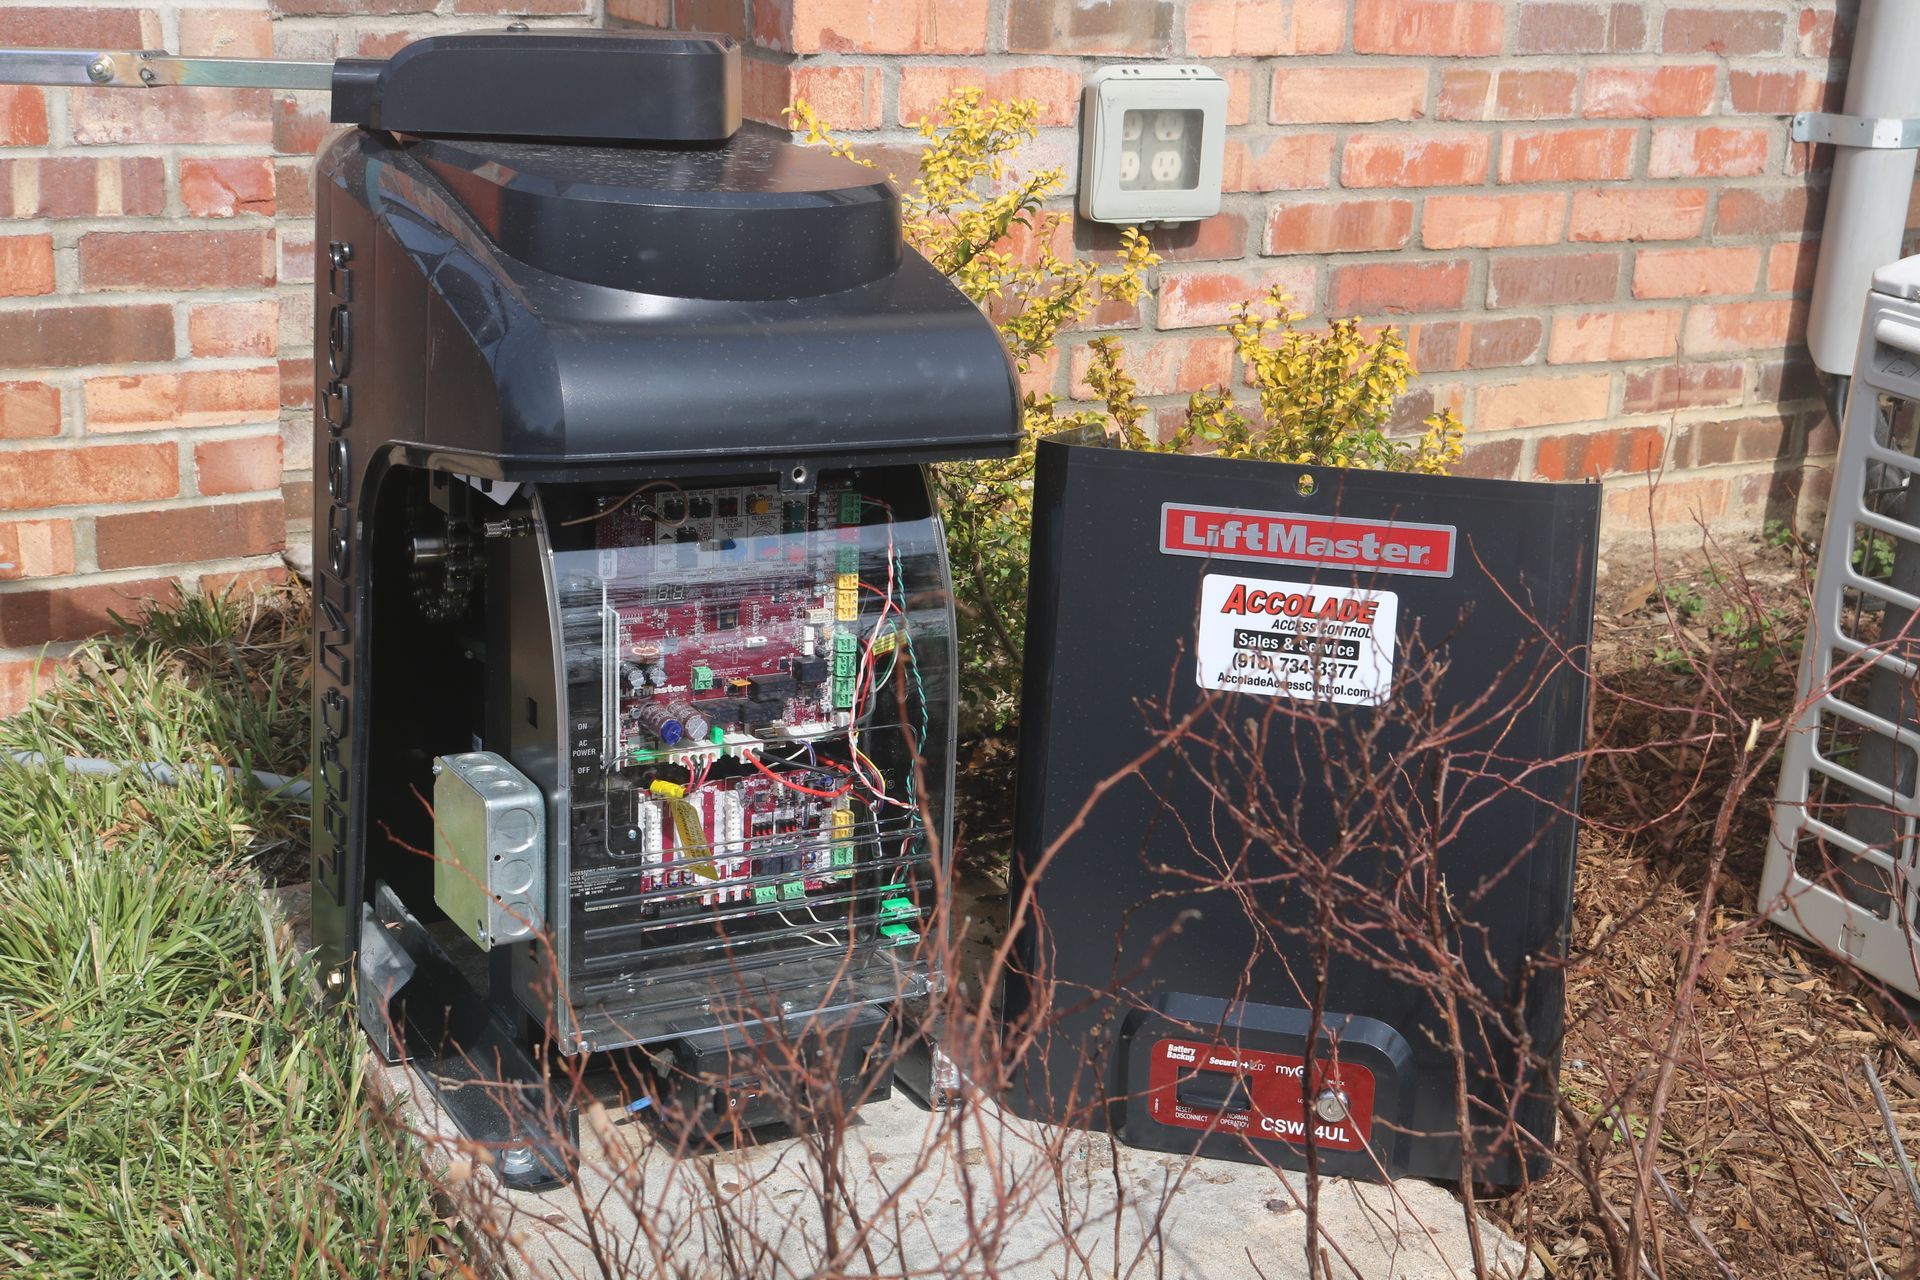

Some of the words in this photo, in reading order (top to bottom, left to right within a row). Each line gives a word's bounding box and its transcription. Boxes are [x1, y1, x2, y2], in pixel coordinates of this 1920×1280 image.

[1183, 515, 1430, 564] LiftMaster
[1221, 584, 1379, 624] ACCOLADE
[1239, 633, 1278, 649] Sales
[1283, 637, 1295, 651] &
[1299, 640, 1355, 657] Sevice
[1217, 672, 1370, 698] AccoladeAcessCntrol.com
[572, 748, 596, 757] POWER
[1166, 1051, 1195, 1062] Backup
[1168, 1044, 1196, 1055] Battery
[1175, 1112, 1208, 1122] DISCONNECT
[1227, 1113, 1249, 1121] NORMAL
[1261, 1117, 1349, 1142] CSW4UL
